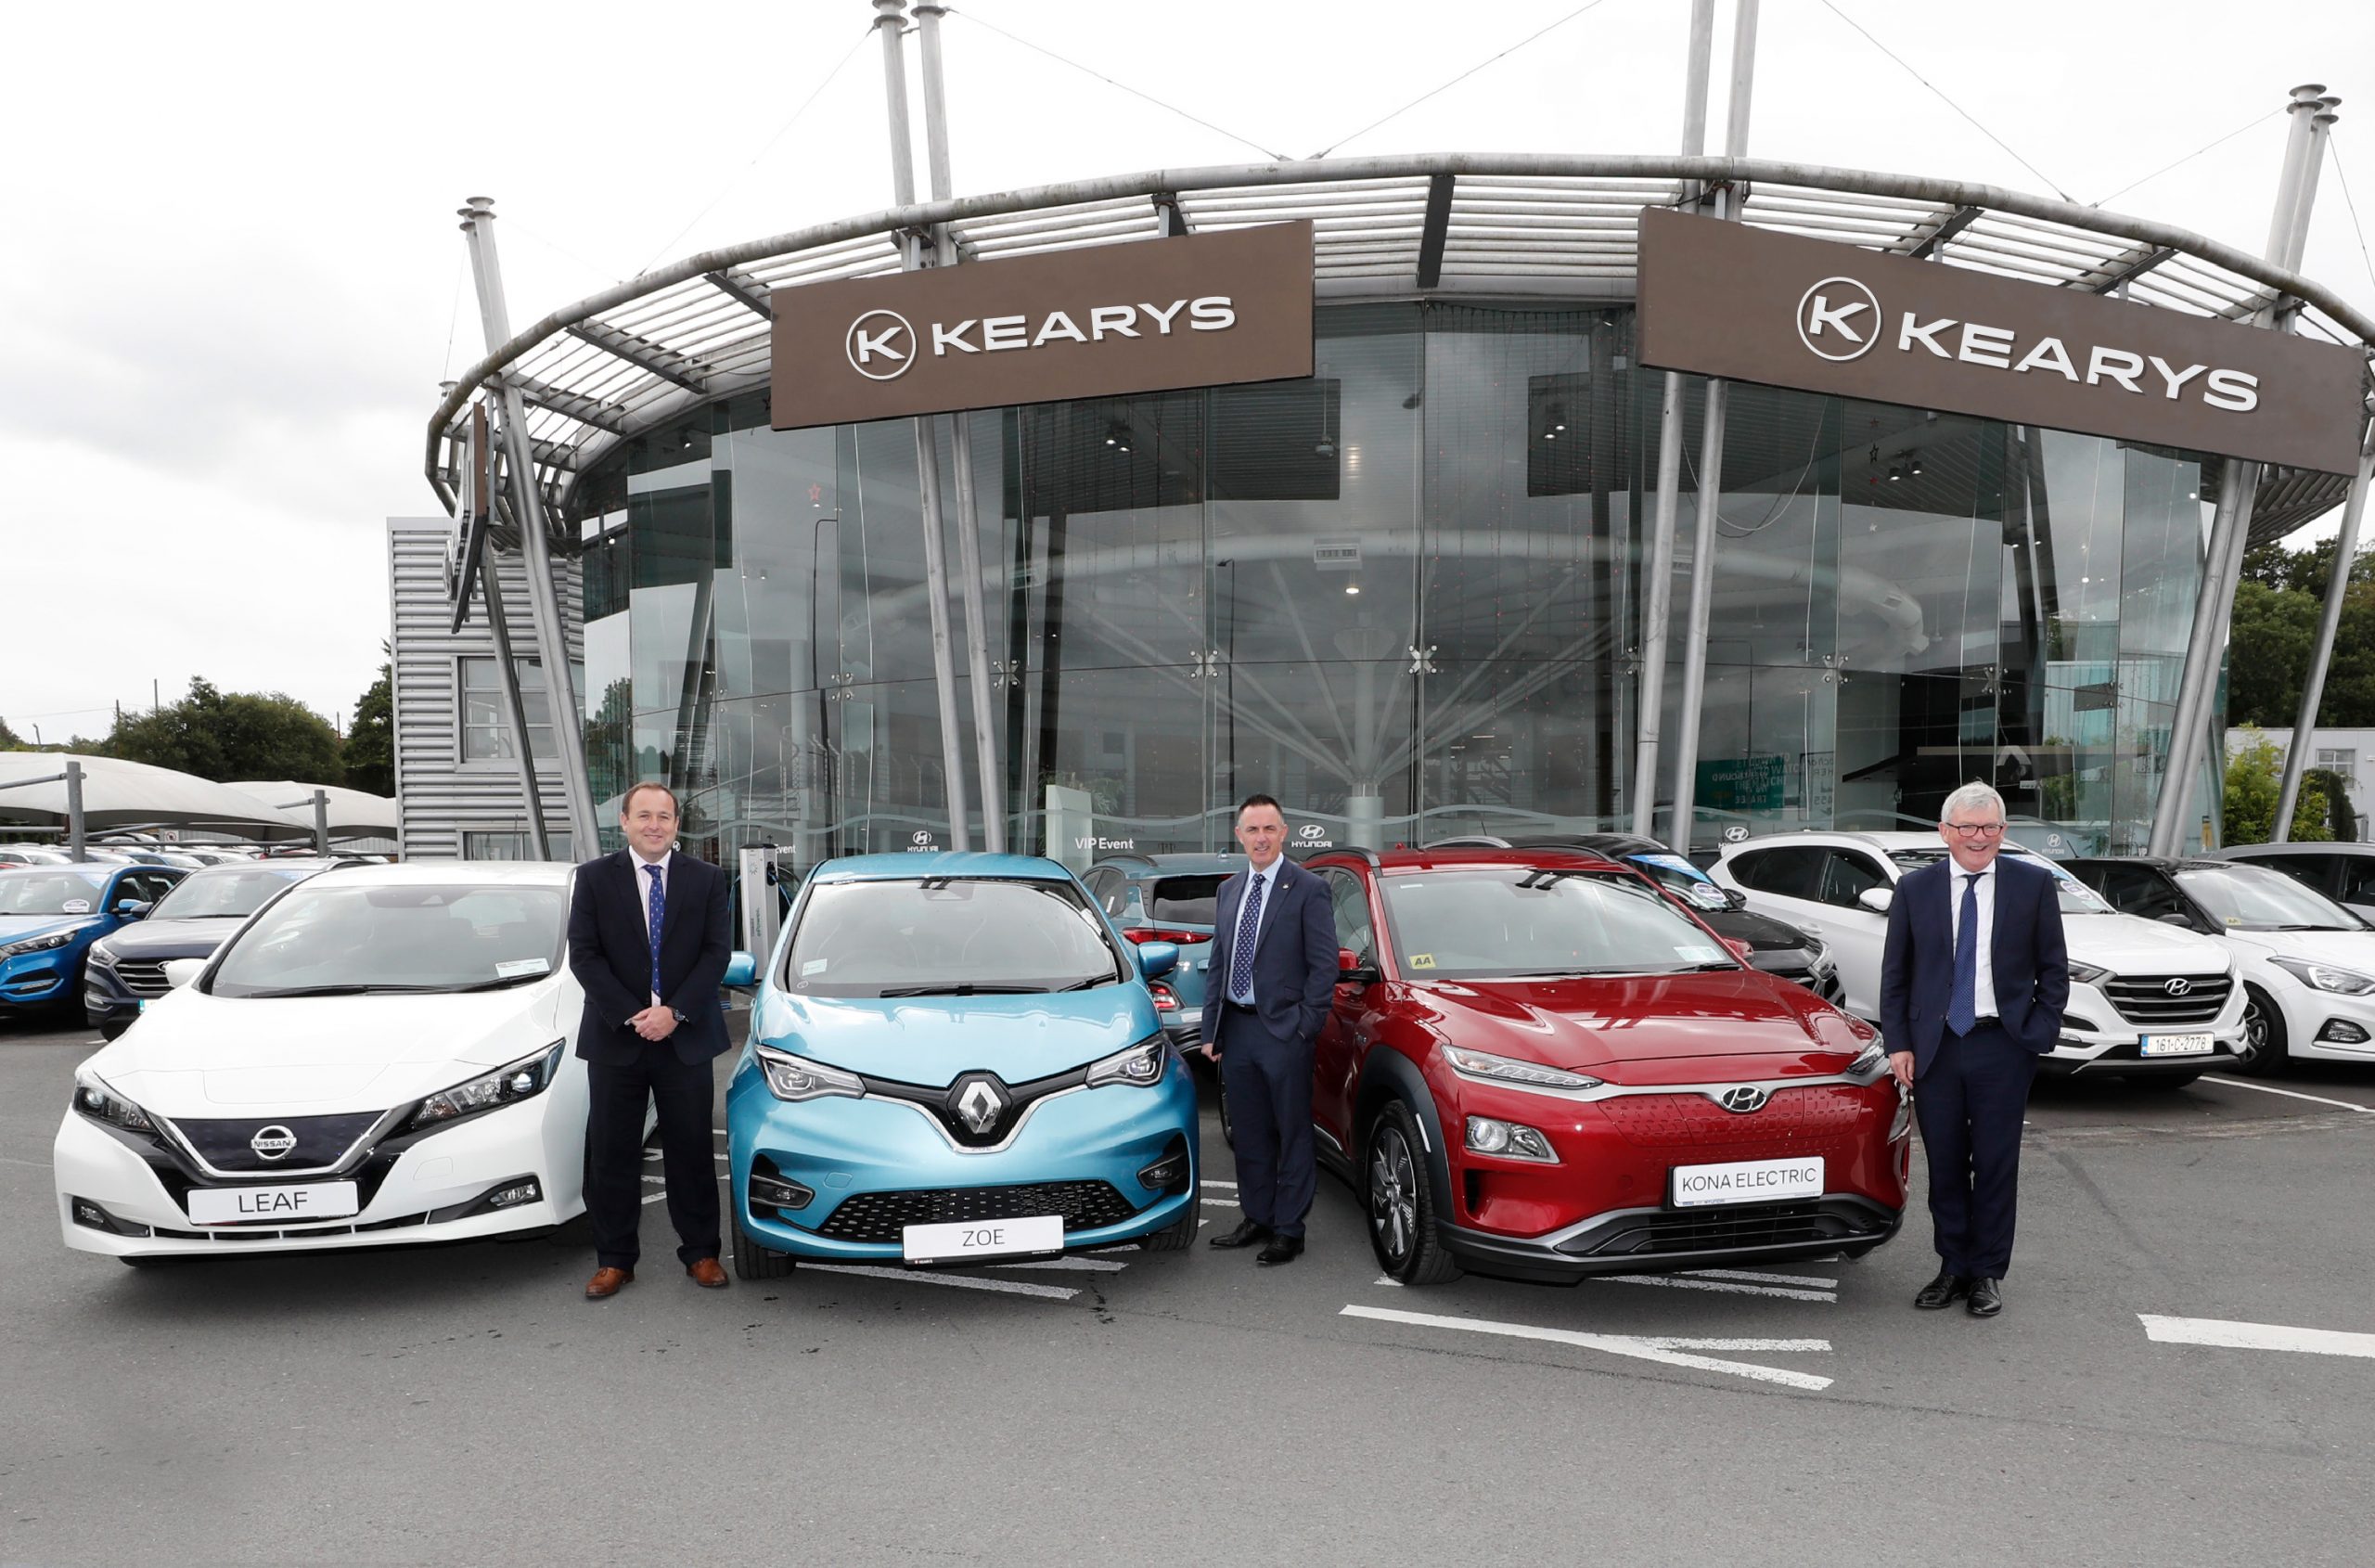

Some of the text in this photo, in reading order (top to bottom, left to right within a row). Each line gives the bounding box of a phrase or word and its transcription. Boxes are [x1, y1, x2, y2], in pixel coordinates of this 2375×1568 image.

[931, 296, 1236, 355] KEARYS
[1897, 311, 2260, 412] KEARYS
[1074, 837, 1134, 849] VIP Event
[1414, 957, 1431, 966] AA
[1682, 1167, 1817, 1192] KONA ELECTRIC
[238, 1191, 308, 1214] LEAF
[962, 1228, 1006, 1247] ZOE
